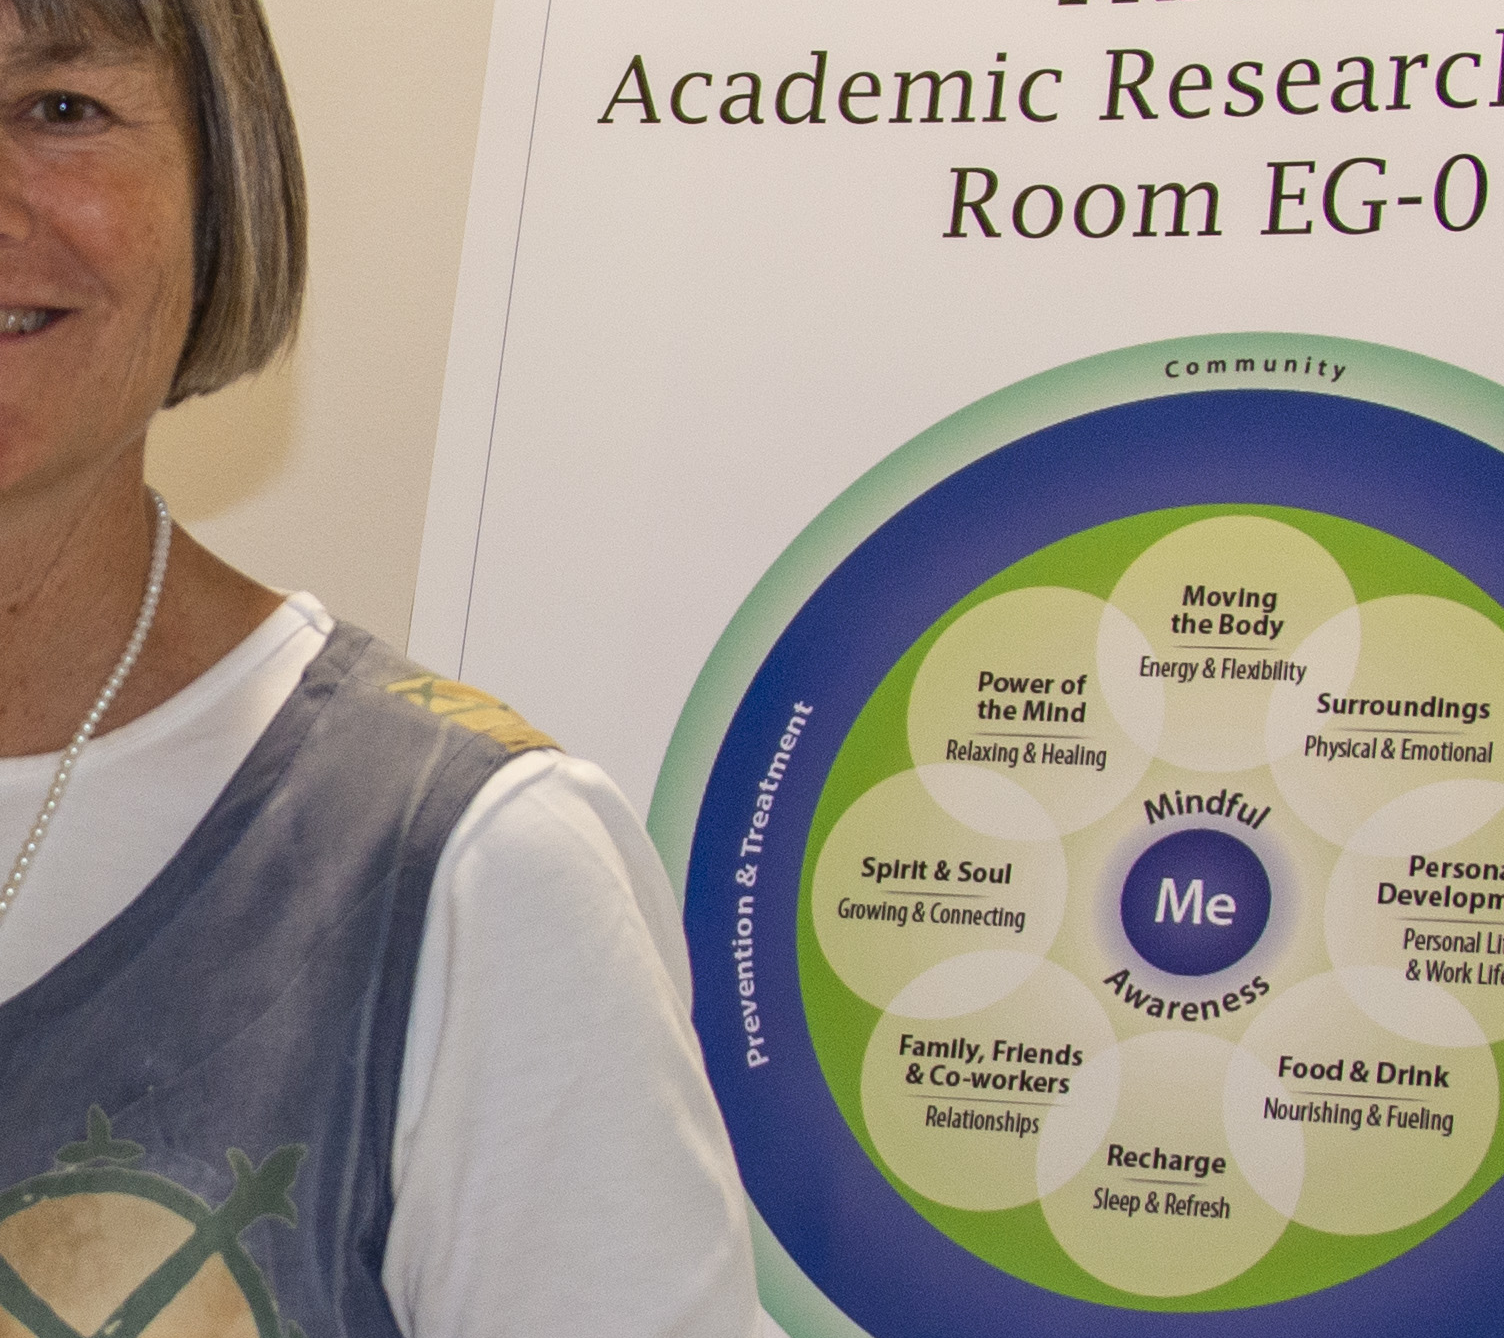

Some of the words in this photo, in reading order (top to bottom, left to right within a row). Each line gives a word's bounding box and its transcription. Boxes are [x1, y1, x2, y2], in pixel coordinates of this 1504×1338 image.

[598, 51, 1063, 125] Academic
[943, 166, 1224, 239] Room
[1165, 356, 1346, 383] Community
[1182, 585, 1278, 614] Moving
[1171, 613, 1213, 635] the
[1218, 615, 1284, 640] Body
[978, 671, 1055, 695] Power
[1061, 674, 1088, 695] of
[1139, 656, 1199, 684] Energy
[1202, 659, 1216, 679] &
[1221, 658, 1307, 685] Flexibility
[977, 699, 1017, 721] the
[1022, 700, 1087, 723] Mind
[1316, 693, 1491, 724] Surroundings
[946, 739, 1019, 768] Relaxing
[1022, 743, 1037, 763] &
[1041, 743, 1107, 771] Healing
[1304, 735, 1377, 761] Physical
[1381, 738, 1395, 758] &
[1401, 738, 1493, 763] Emotional
[740, 700, 814, 858] Treatment
[1143, 789, 1272, 830] Mindful
[736, 863, 758, 888] &
[861, 857, 929, 883] Spirit
[934, 861, 951, 881] &
[957, 861, 1012, 885] Soul
[837, 897, 908, 927] Growing
[911, 901, 926, 921] &
[930, 902, 1026, 933] Connecting
[1154, 878, 1237, 926] Me
[1403, 928, 1481, 954] Personal
[731, 894, 770, 1070] Prevention
[1406, 959, 1421, 982] &
[1426, 961, 1473, 984] Work
[1103, 968, 1271, 1022] Awareness
[899, 1034, 985, 1064] Family,
[992, 1040, 1083, 1066] Friends
[905, 1064, 924, 1084] &
[929, 1064, 1070, 1094] Co-workers
[1278, 1056, 1344, 1081] Food
[1350, 1062, 1369, 1082] &
[1376, 1062, 1450, 1088] Drink
[925, 1105, 1040, 1138] Relationships
[1264, 1097, 1362, 1130] Nourishing
[1366, 1105, 1382, 1126] &
[1387, 1105, 1454, 1137] Fueling
[1107, 1144, 1226, 1178] Recharge
[1093, 1187, 1140, 1218] Sleep
[1145, 1190, 1160, 1213] &
[1164, 1192, 1231, 1219] Refresh
